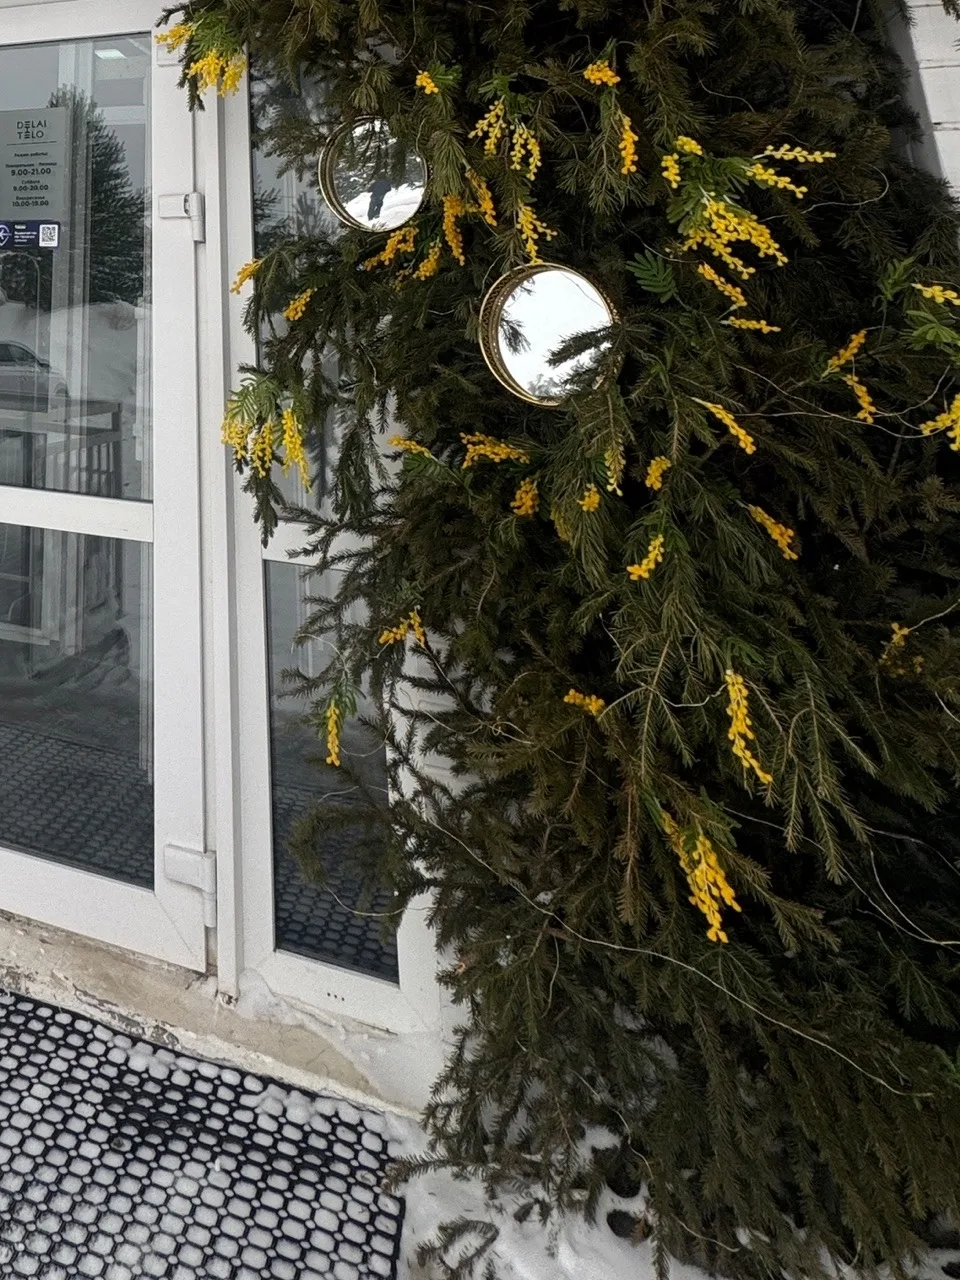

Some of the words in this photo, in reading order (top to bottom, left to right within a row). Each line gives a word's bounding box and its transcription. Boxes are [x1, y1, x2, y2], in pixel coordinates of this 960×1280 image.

[16, 120, 47, 129] DELAI
[16, 130, 44, 139] TELO
[11, 168, 51, 176] 9.00-21.00
